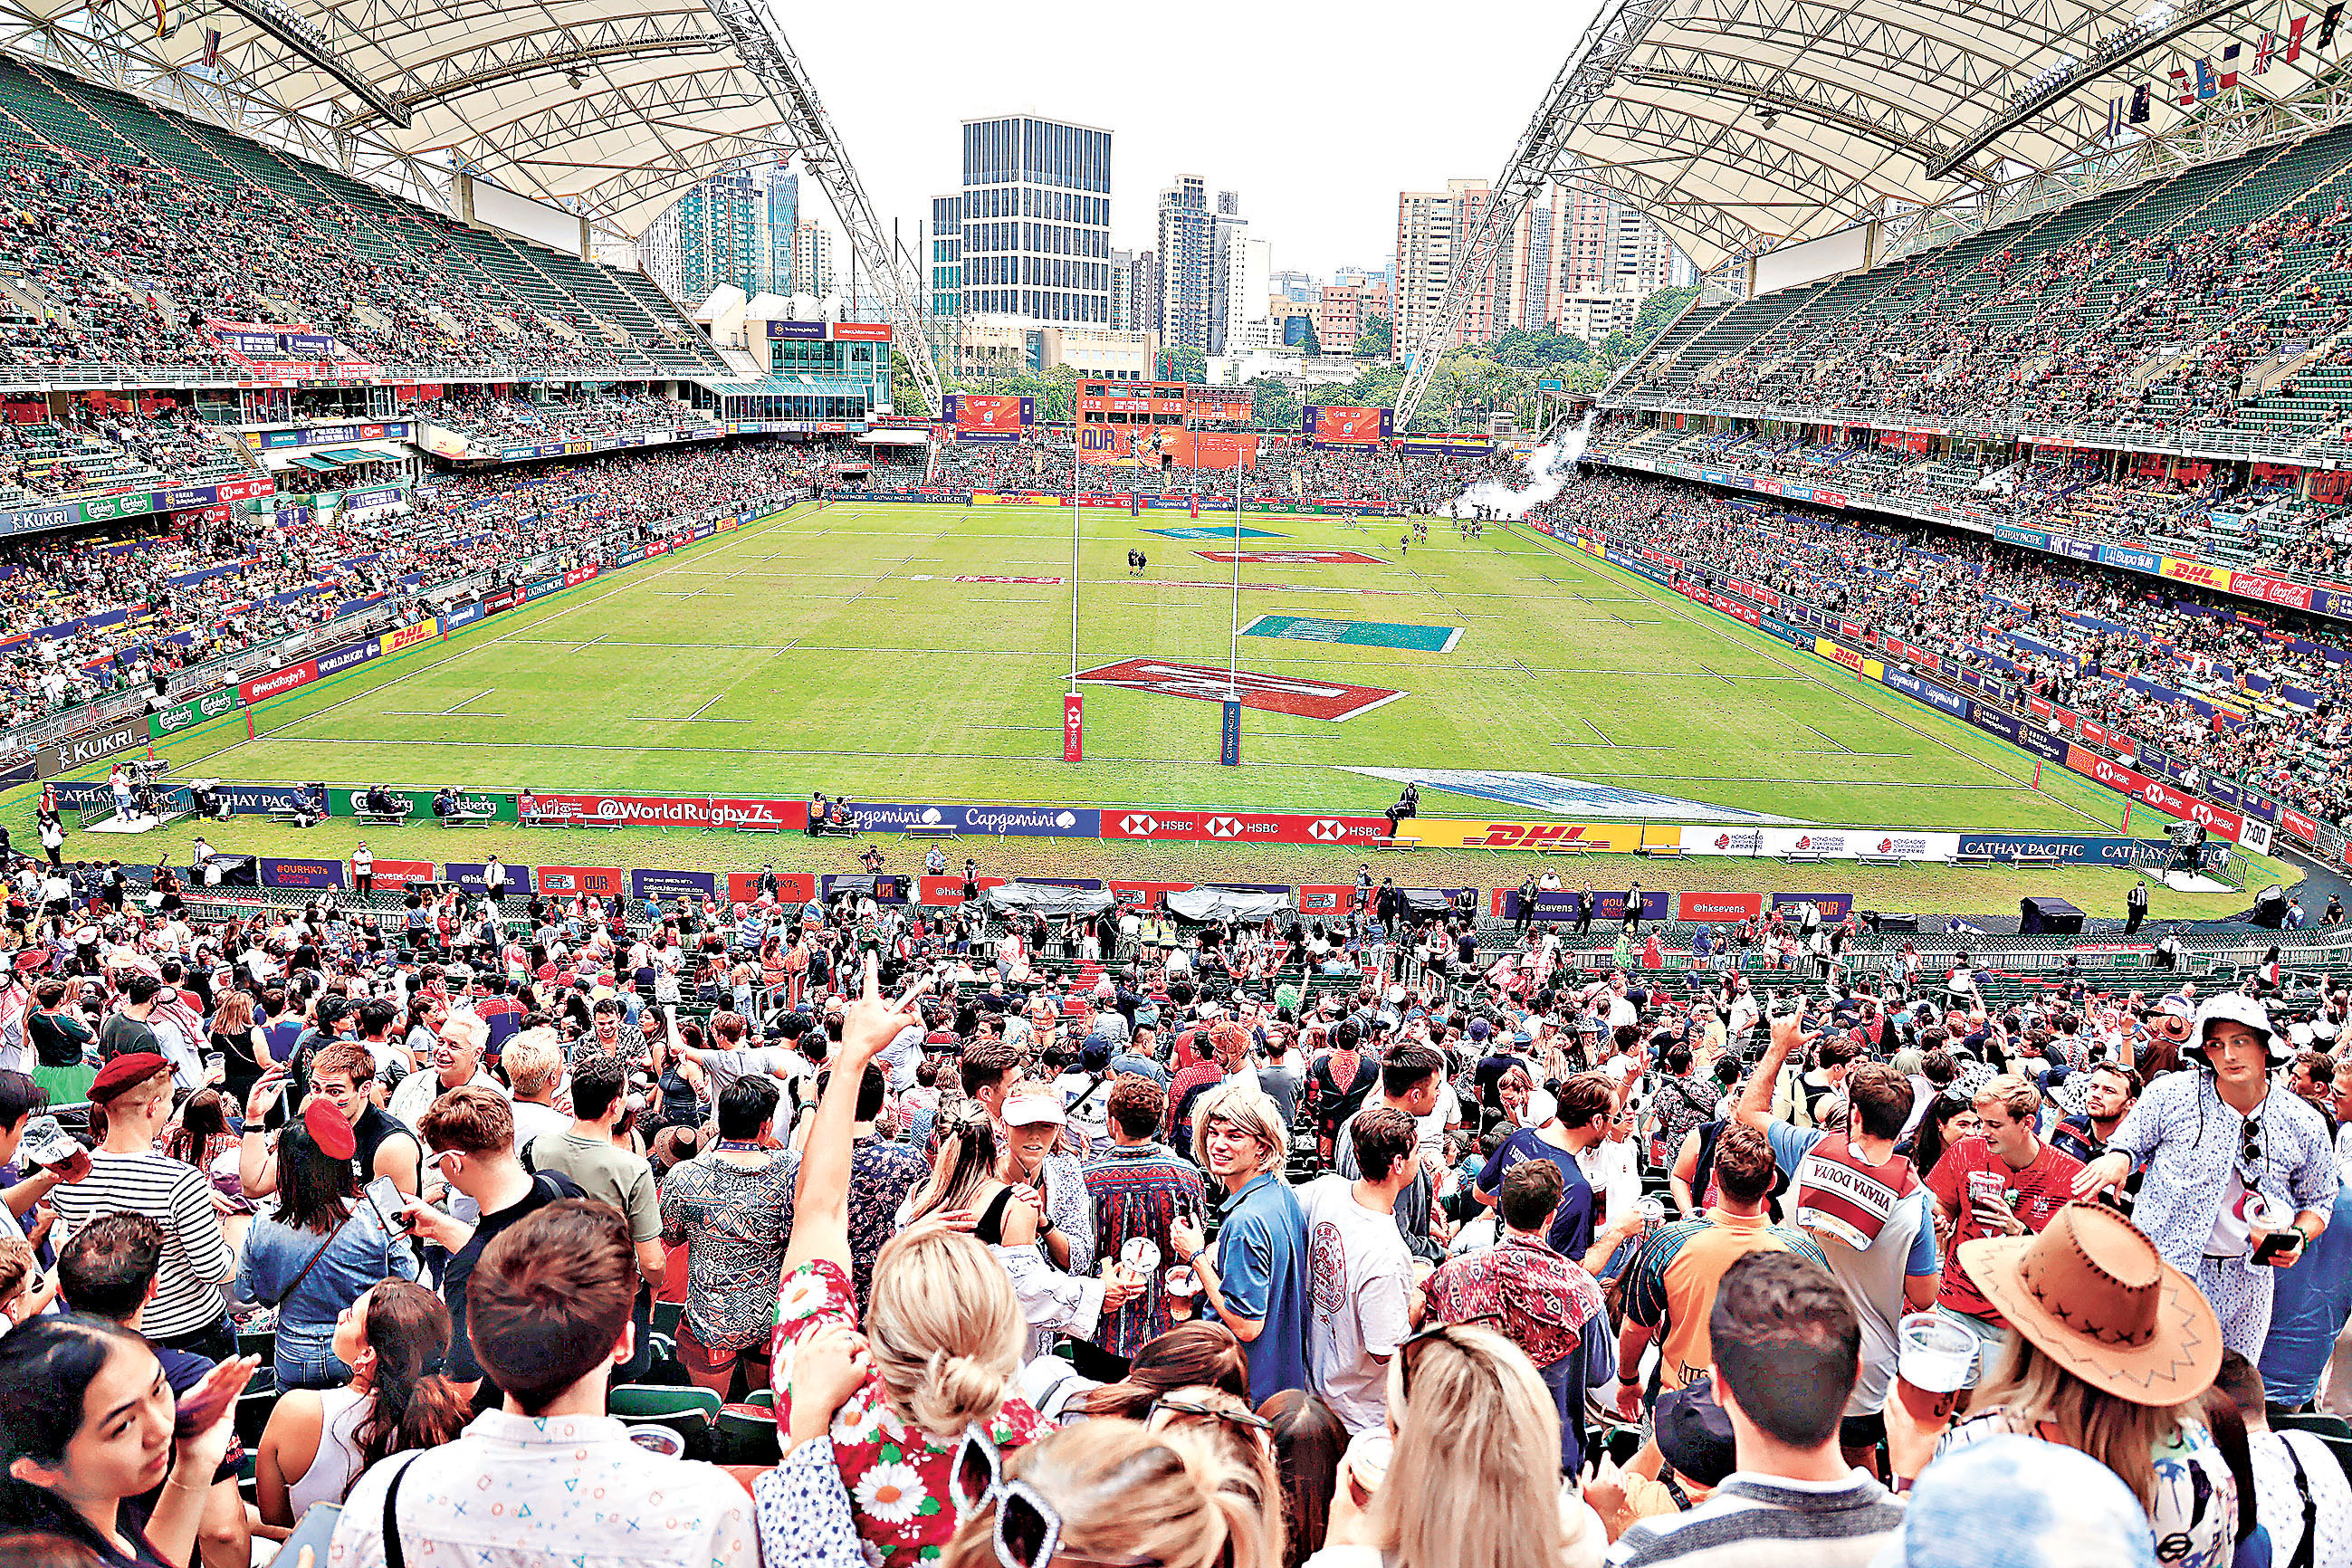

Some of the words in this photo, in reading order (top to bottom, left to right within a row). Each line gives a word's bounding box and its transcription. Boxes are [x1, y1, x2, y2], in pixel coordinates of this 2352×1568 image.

[87, 500, 116, 518] Carlsberg
[120, 494, 148, 512] Carlsberg
[999, 496, 1036, 505] DHL
[22, 510, 69, 530] KUKRI
[1998, 528, 2021, 540] CATHAY
[2021, 532, 2043, 547] PACIFIC
[2051, 536, 2071, 555] HKT
[2116, 550, 2137, 566] Bupa
[2173, 561, 2216, 586] DHL
[392, 623, 426, 648] DHL
[1834, 647, 1861, 669] DHL
[199, 692, 232, 716] Carlsberg
[158, 707, 193, 731] Carlsberg
[1228, 707, 1236, 732] PACIFIC
[73, 728, 133, 763] KUKRI
[1226, 732, 1236, 759] CATHAY
[2114, 772, 2129, 785] HSBC
[2165, 795, 2183, 808] HSBC
[854, 807, 922, 830] pgemini
[965, 808, 1055, 834] Capgemini
[1161, 820, 1193, 831] HSBC
[1247, 823, 1279, 833] HSBC
[2214, 817, 2235, 831] HSBC
[1349, 826, 1382, 837] HSBC
[1485, 825, 1590, 847] DHL
[2243, 822, 2266, 846] 7:00
[1965, 842, 2028, 856] CATHAY
[2027, 844, 2085, 857] PACIFIC
[584, 875, 608, 890] OUR
[1535, 904, 1573, 913] ksevens
[1693, 904, 1745, 914] @hksevens
